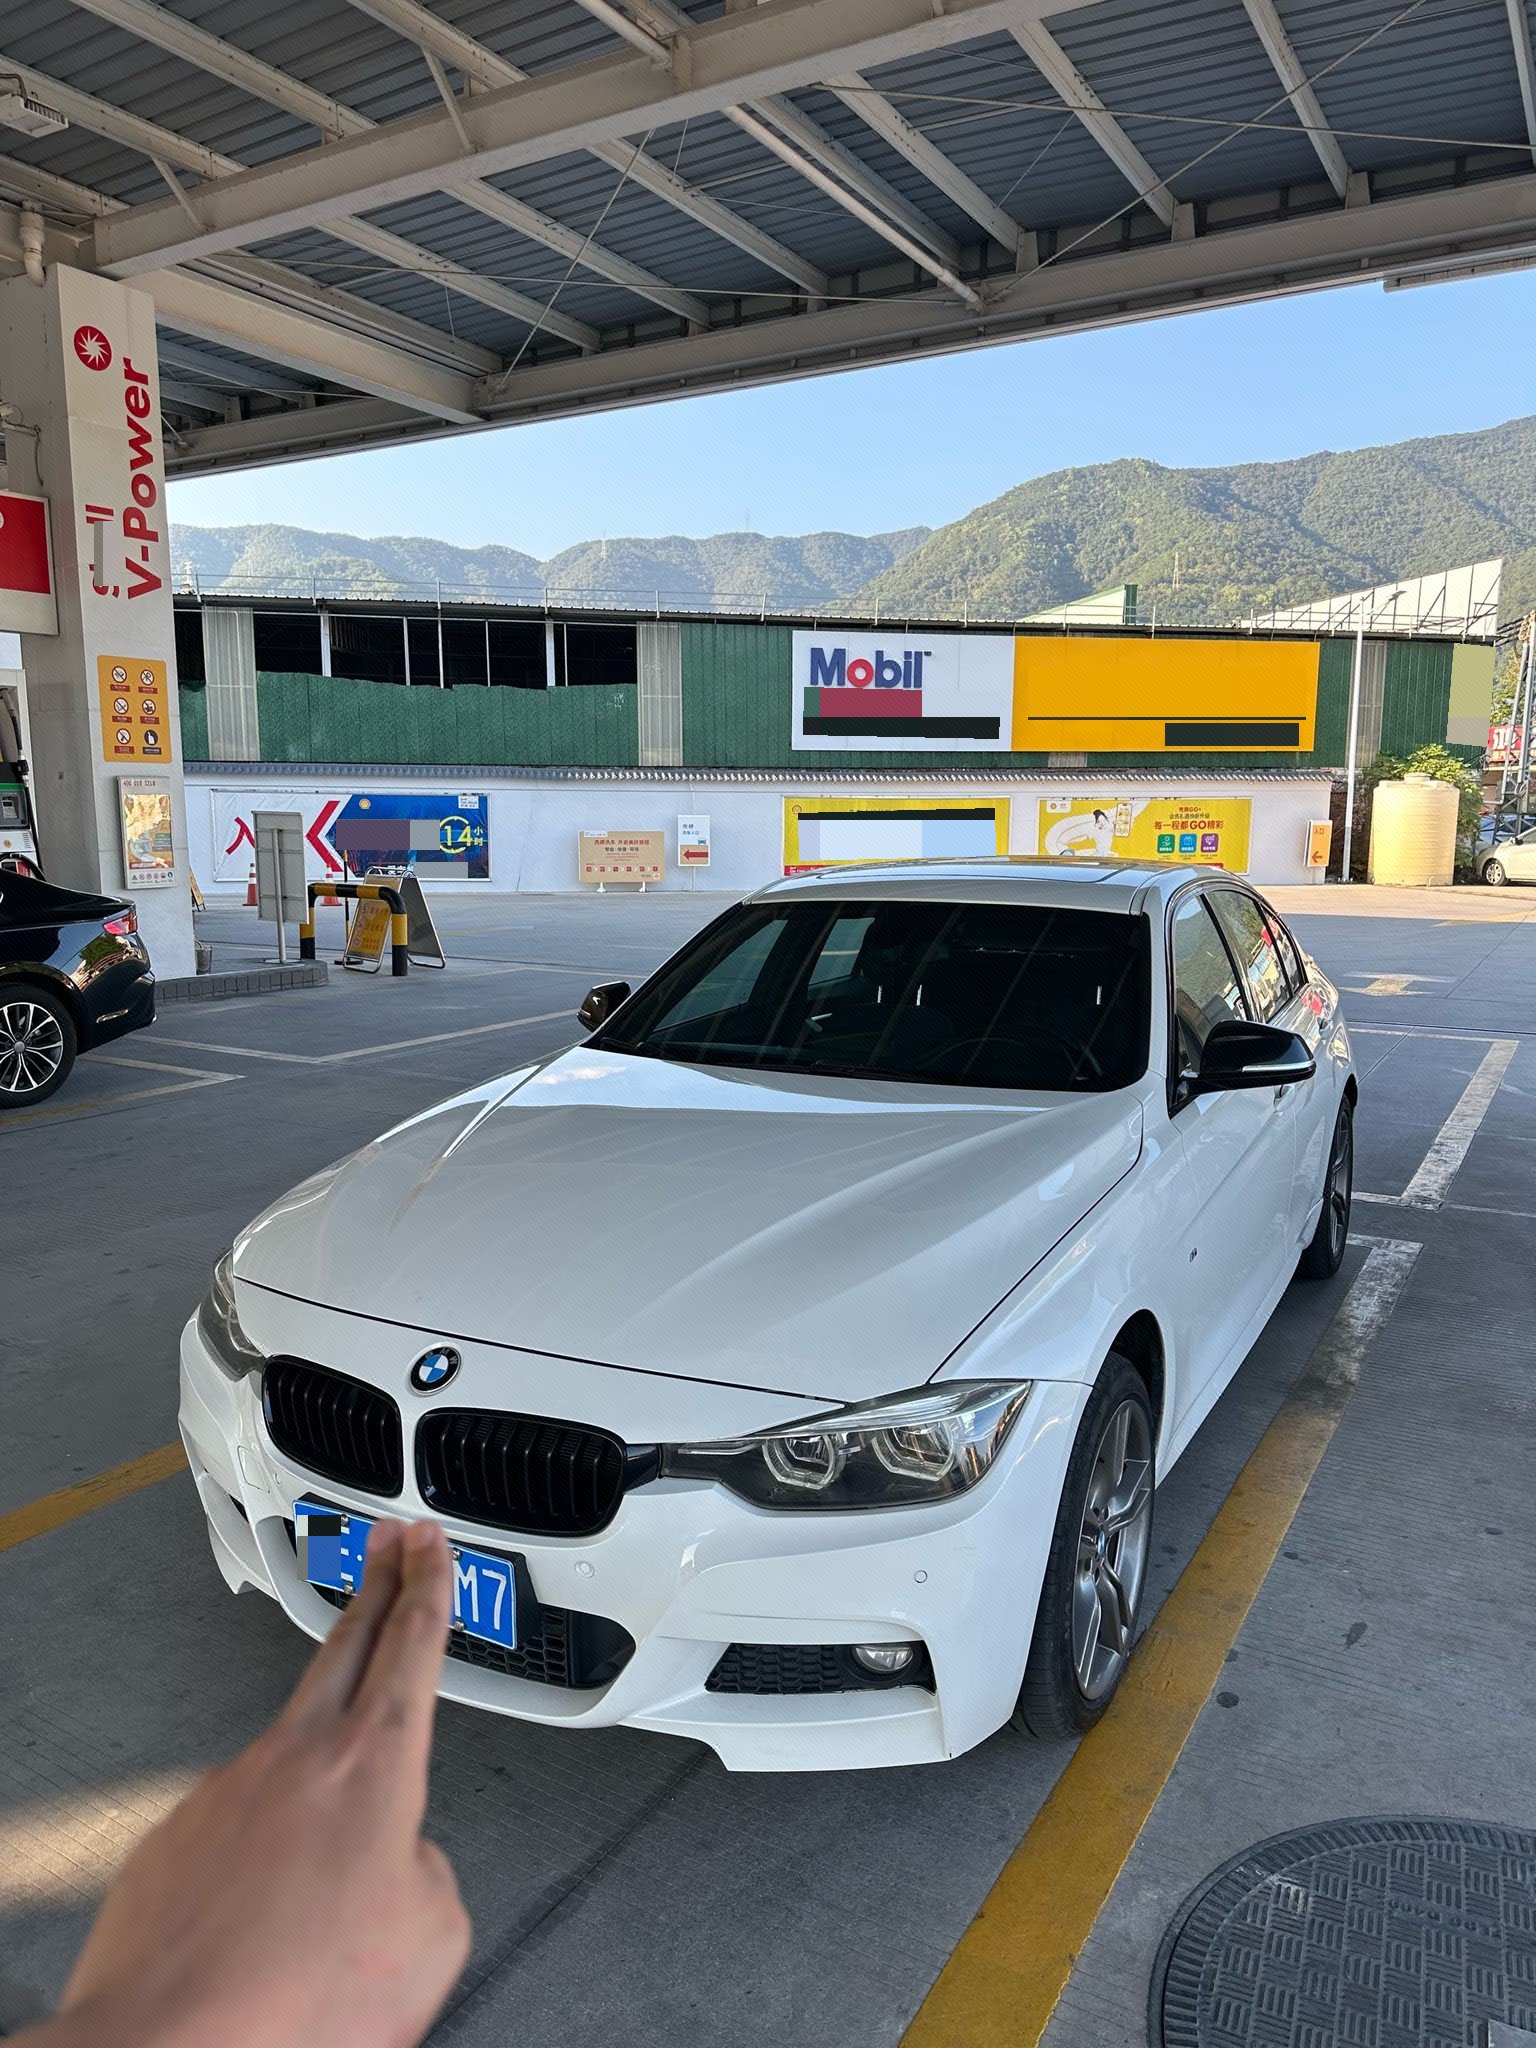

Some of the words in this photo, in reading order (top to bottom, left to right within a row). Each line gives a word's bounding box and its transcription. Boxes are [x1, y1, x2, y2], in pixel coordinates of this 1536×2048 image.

[123, 357, 162, 599] V-Power
[810, 647, 923, 688] Mobil
[1154, 820, 1225, 831] 每一程都GO精彩
